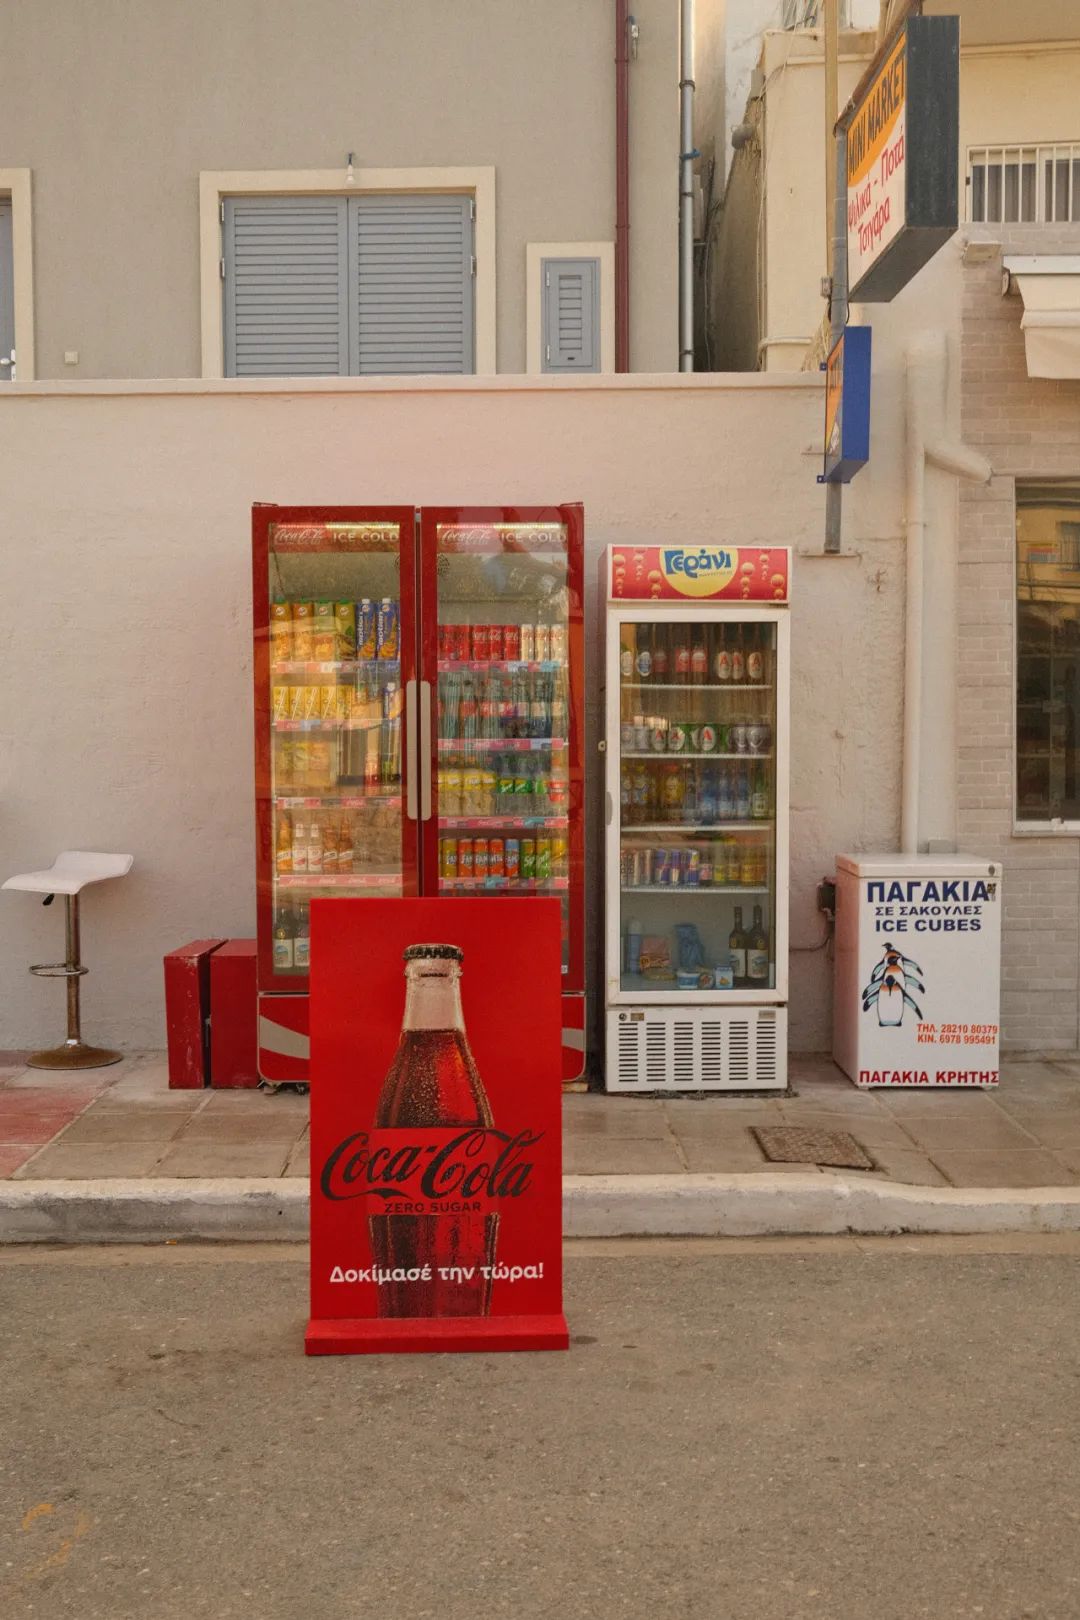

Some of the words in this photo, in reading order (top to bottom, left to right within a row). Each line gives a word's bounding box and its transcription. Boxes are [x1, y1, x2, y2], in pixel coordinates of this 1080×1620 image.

[846, 110, 866, 183] MINI
[867, 48, 905, 152] MARKET
[332, 532, 356, 543] ICE
[361, 532, 399, 543] COLD
[500, 532, 524, 543] ICE
[528, 532, 567, 544] COLD
[664, 549, 732, 579] Γεράνι
[867, 880, 991, 903] ΠΑΓΑΚΙΑ
[875, 906, 893, 916] ΣΕ
[899, 905, 982, 916] ΣΑΚΟΥΛΕΣ
[875, 919, 908, 932] ICE
[914, 918, 982, 932] CUBES
[917, 1023, 938, 1033] ΤΗΛ.
[940, 1023, 969, 1034] 28210
[917, 1034, 937, 1044] ΚΙΝ.
[939, 1034, 961, 1044] 6978
[963, 1035, 996, 1045] 995491
[859, 1070, 930, 1084] ΠΑΓΑΚΙΑ
[935, 1070, 999, 1084] ΚΡΗΤΗΣ
[320, 1127, 545, 1202] Coca-Cola
[384, 1202, 425, 1214] ZERO
[430, 1201, 482, 1213] SUGAR
[329, 1263, 433, 1286] Δοκίμασέ
[437, 1265, 475, 1284] την
[480, 1261, 544, 1283] τώρα!
